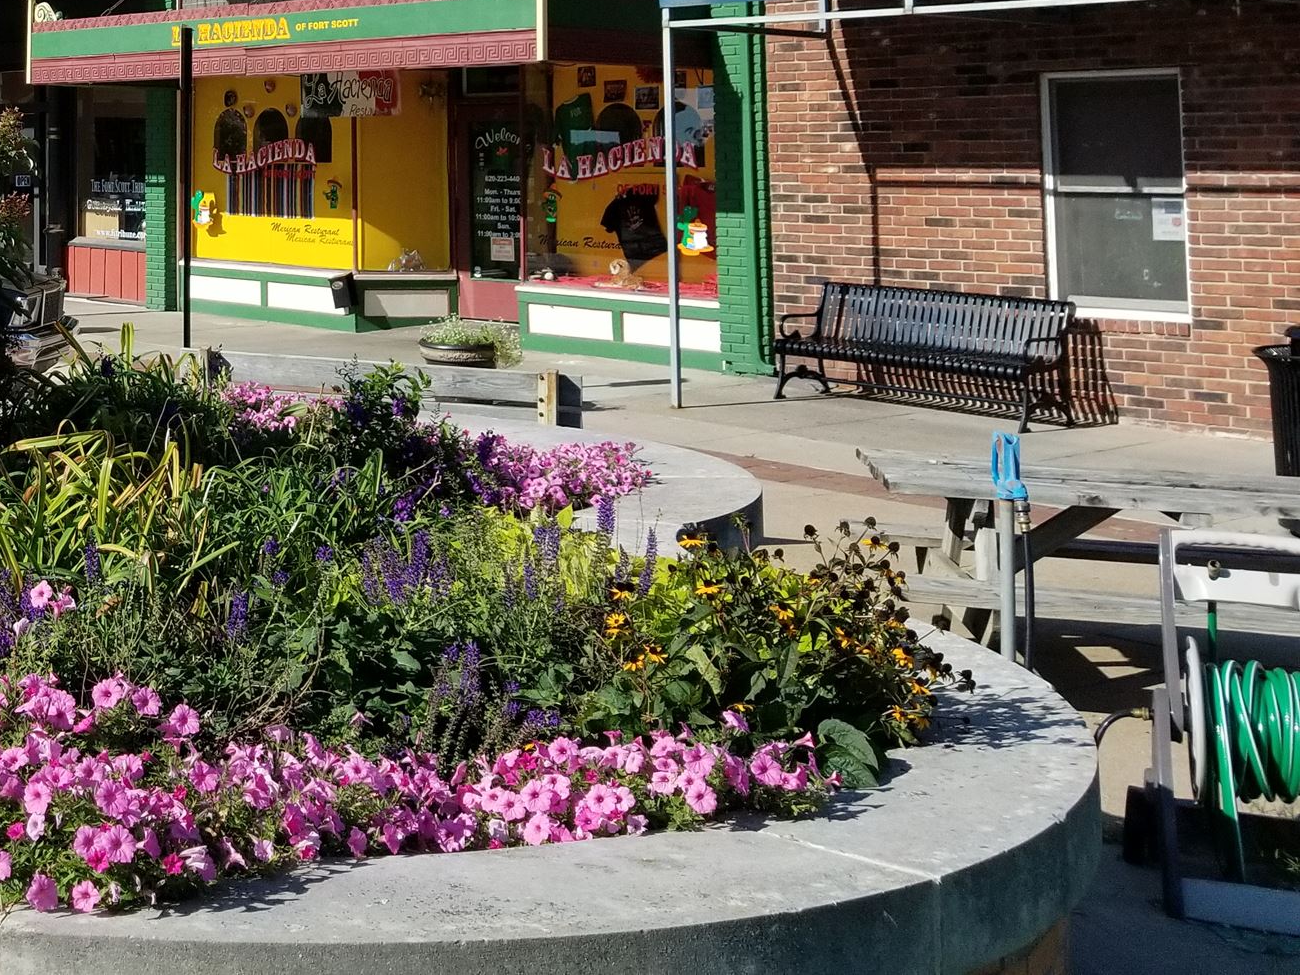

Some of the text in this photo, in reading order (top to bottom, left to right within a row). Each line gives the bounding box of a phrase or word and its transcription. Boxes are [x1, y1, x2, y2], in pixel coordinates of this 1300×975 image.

[171, 16, 359, 47] L HACIENDA OF FORT SCOTT
[304, 71, 394, 109] La Hacienda
[213, 138, 317, 174] LA HACIENDA
[542, 135, 699, 180] LA HACIENA
[90, 179, 101, 193] THE
[101, 179, 115, 193] FORT
[115, 179, 131, 193] SCOTT
[271, 222, 300, 234] Mexican
